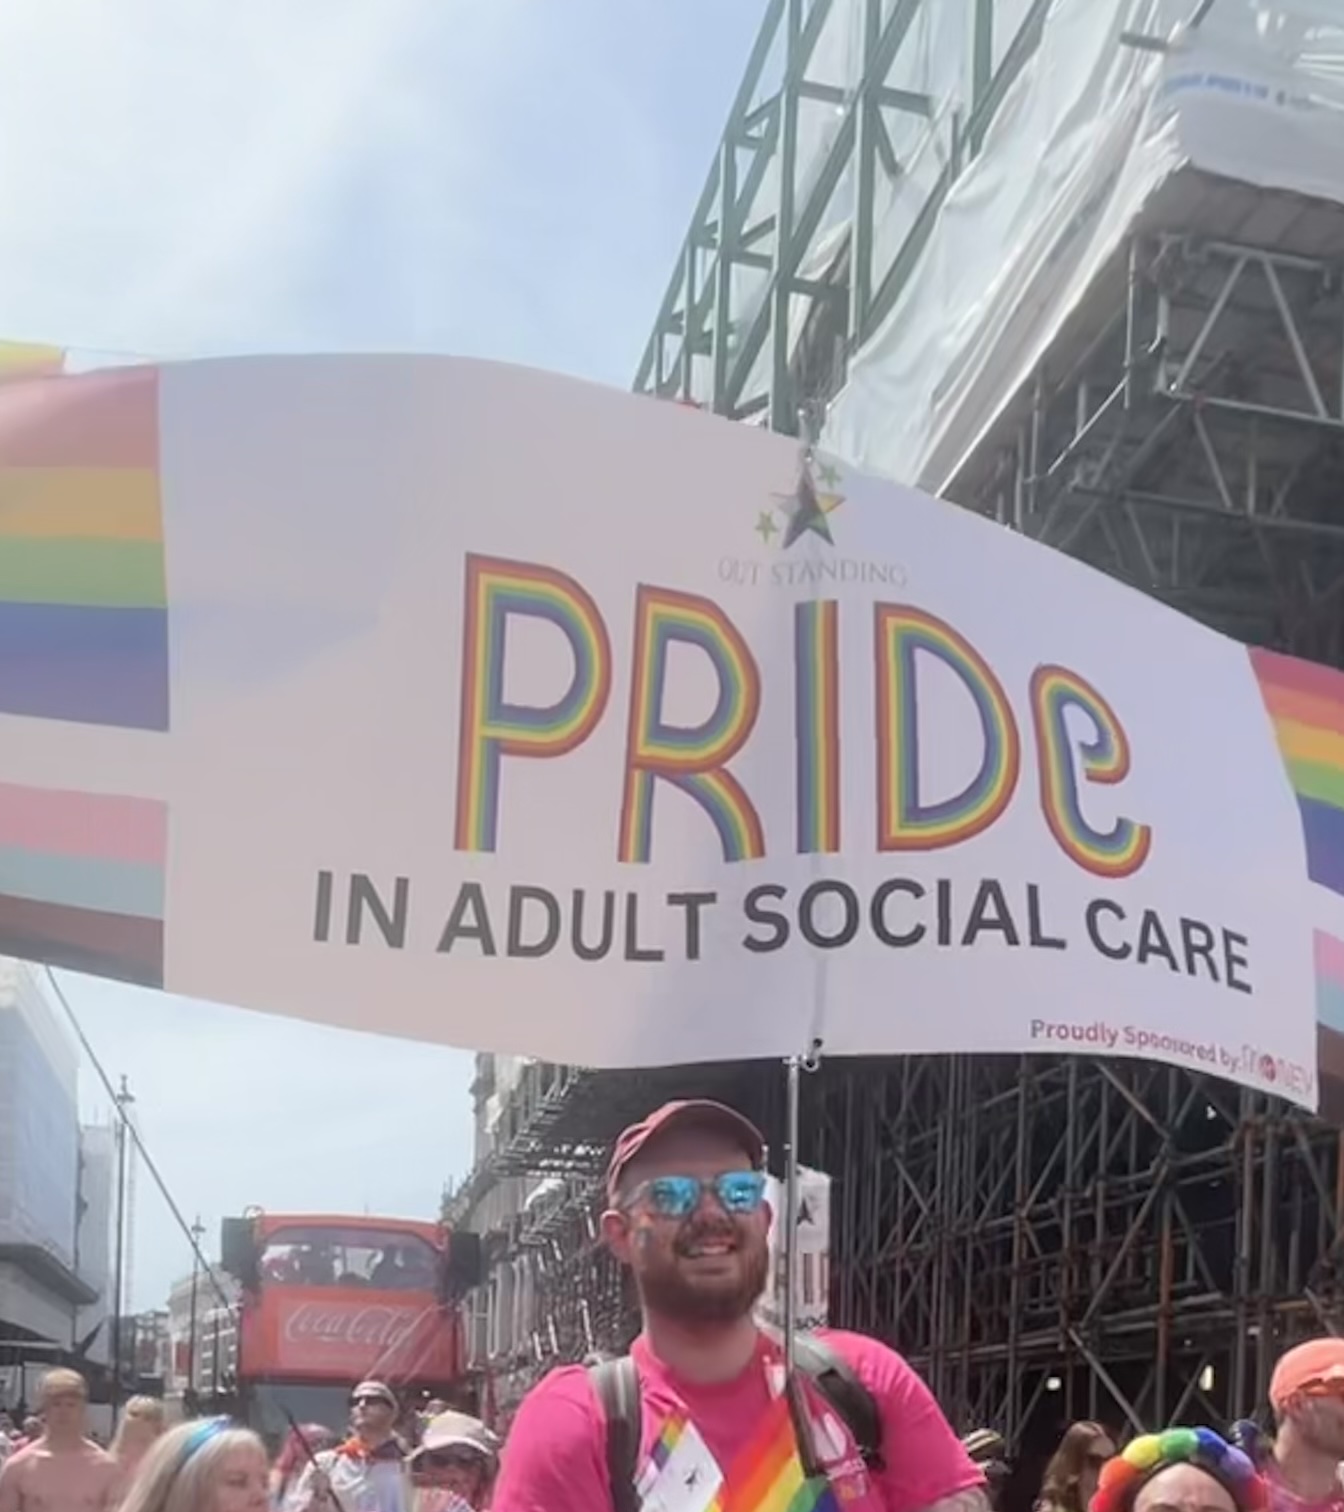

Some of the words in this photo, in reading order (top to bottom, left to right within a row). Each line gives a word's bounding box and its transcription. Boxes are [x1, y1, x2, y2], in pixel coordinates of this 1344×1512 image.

[717, 555, 761, 587] OUT
[771, 557, 908, 589] STANDING
[313, 869, 409, 950] IN
[435, 881, 717, 962] ADULT
[742, 877, 1067, 953] SOCIAL
[1085, 898, 1254, 995] CARE
[1030, 1018, 1119, 1048] Proudly
[1123, 1025, 1217, 1064] Sponsored
